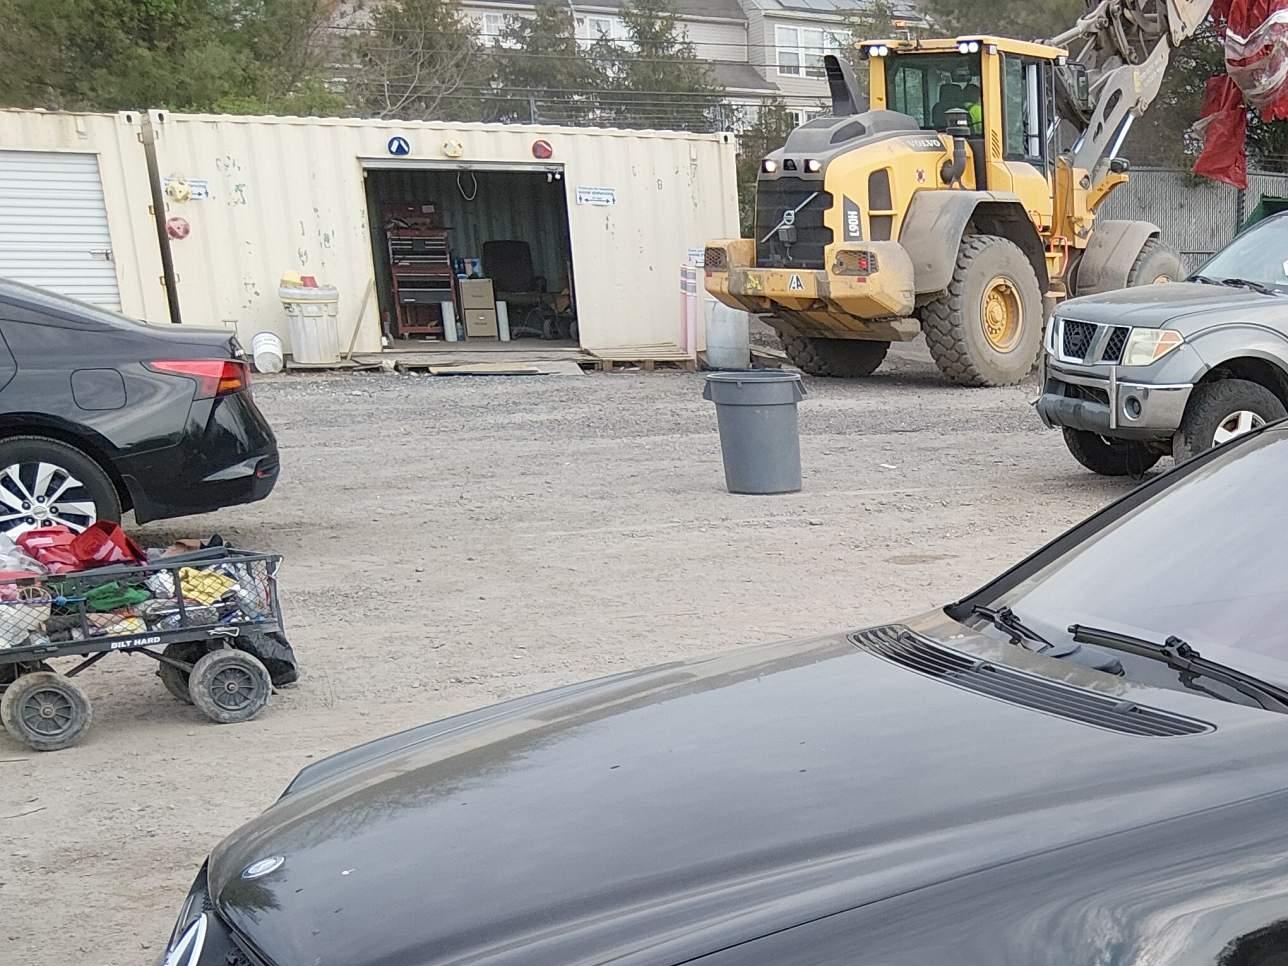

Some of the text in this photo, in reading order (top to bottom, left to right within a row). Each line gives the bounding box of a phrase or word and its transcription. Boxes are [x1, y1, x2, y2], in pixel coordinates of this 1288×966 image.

[906, 139, 941, 147] VOLVO
[847, 210, 860, 237] L90H
[110, 636, 161, 649] BILT HARD
